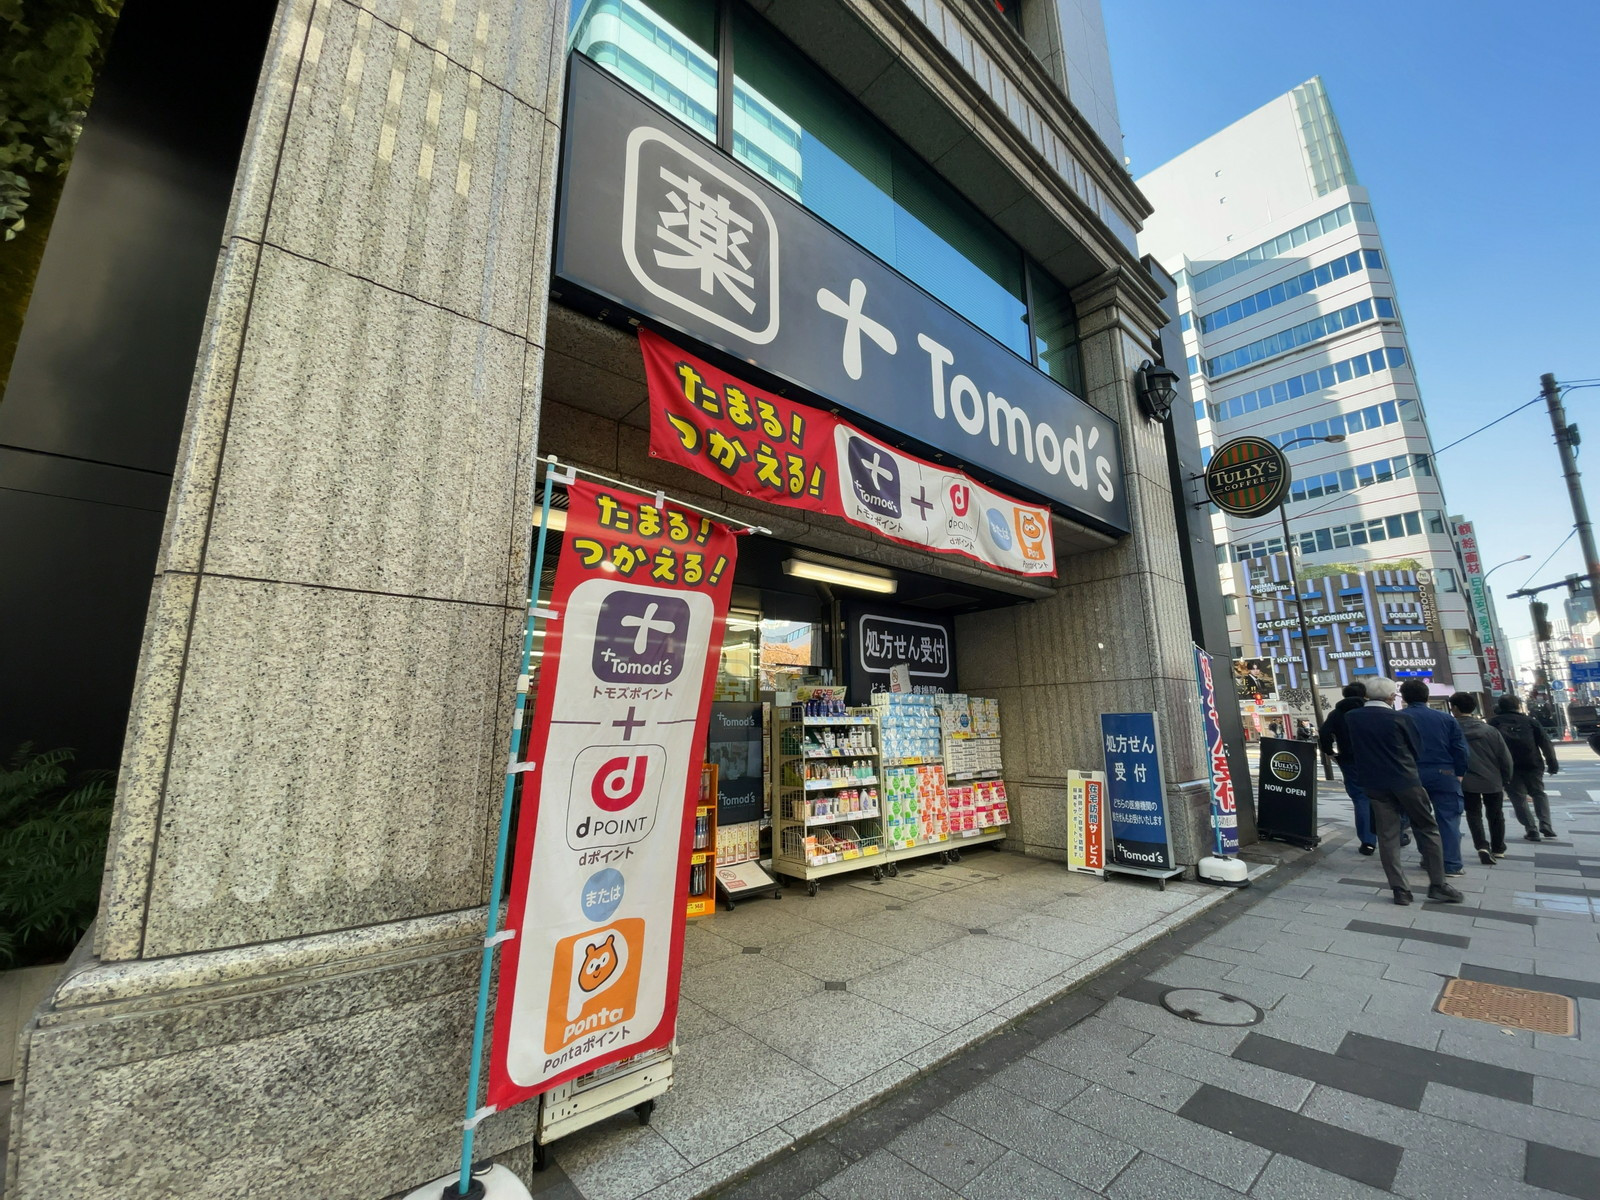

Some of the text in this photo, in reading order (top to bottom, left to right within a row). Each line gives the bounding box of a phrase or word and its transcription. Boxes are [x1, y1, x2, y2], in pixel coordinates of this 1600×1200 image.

[653, 166, 757, 315] 薬
[917, 332, 1115, 503] Tomod's
[1211, 460, 1278, 487] TULLY'S
[1224, 477, 1267, 492] COFFEE
[1250, 582, 1276, 591] ANIMAL
[1256, 584, 1290, 595] HOSPITAL
[1257, 611, 1364, 630] CAT CAFE COORIKUYA
[865, 628, 945, 664] 処方せん受付
[1276, 655, 1303, 663] HOTEL
[1329, 650, 1371, 659] TRIMMING
[1389, 658, 1437, 667] COO&RIKU
[611, 657, 673, 676] Tomod's
[593, 686, 673, 700] トモズポイント
[722, 715, 755, 728] Tomod's
[1106, 734, 1154, 754] 処方せん
[1264, 784, 1307, 797] NOW OPEN
[722, 792, 756, 806] Tomod's
[1088, 784, 1098, 865] 在宅訪問サービス
[1222, 838, 1239, 848] Tomo
[578, 846, 634, 867] dポイント
[1122, 848, 1164, 864] Tomod's
[584, 883, 622, 908] または
[542, 1026, 631, 1074] Pontaポイント
